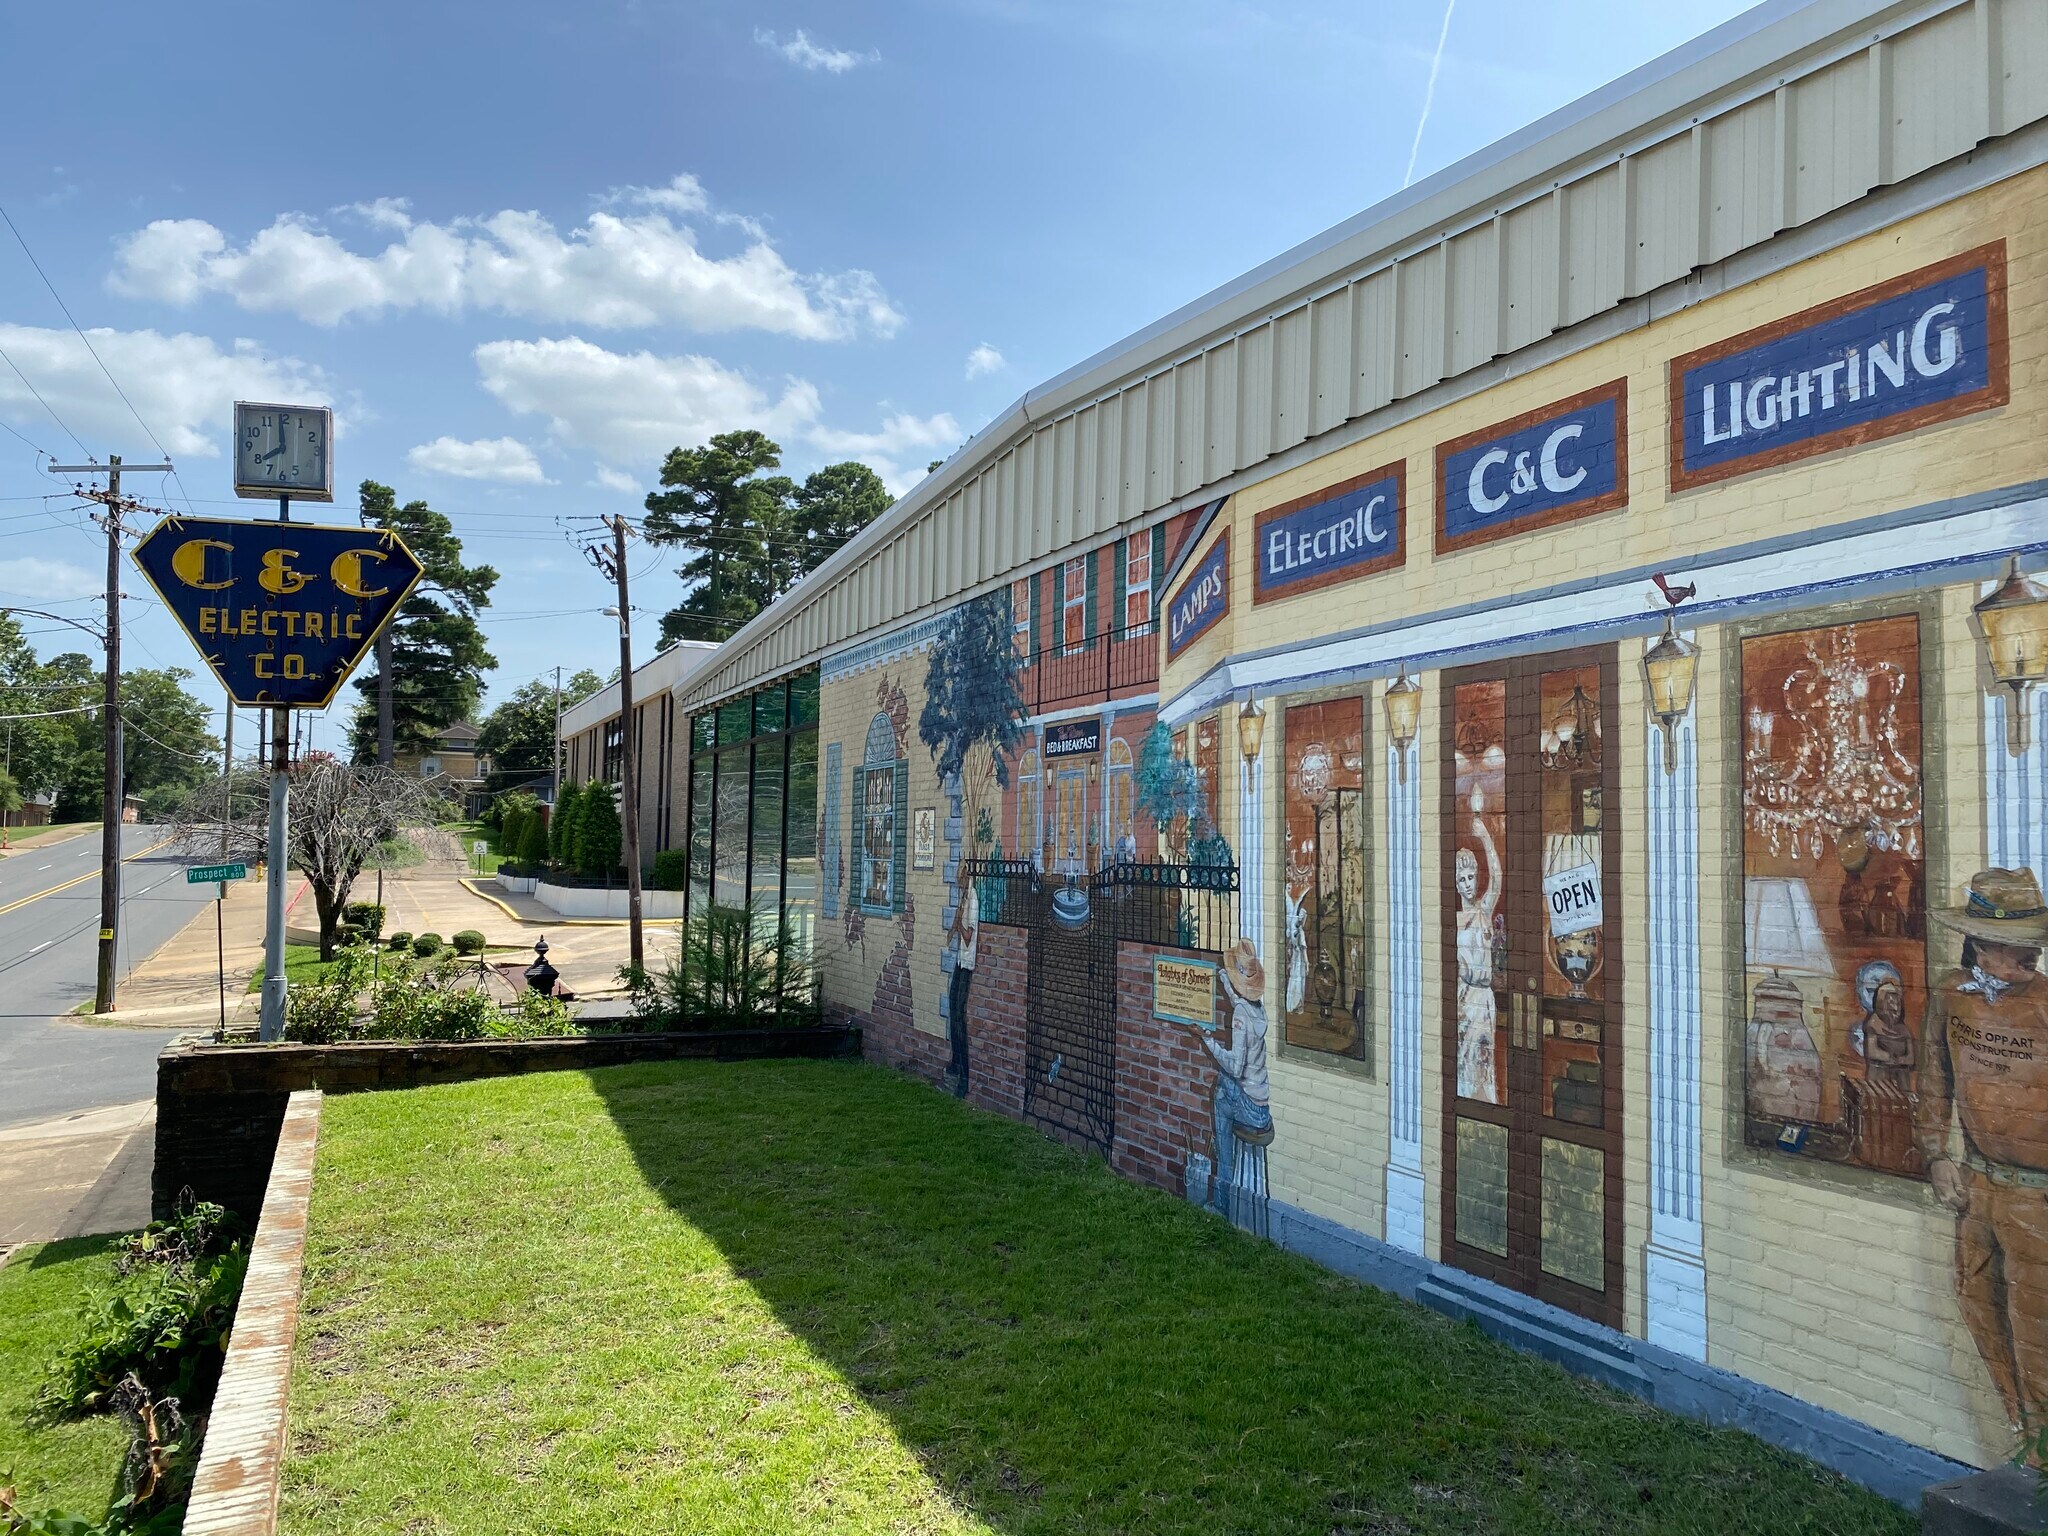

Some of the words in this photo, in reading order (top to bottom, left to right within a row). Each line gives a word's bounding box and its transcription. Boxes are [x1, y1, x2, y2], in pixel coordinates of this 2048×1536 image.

[1704, 302, 1958, 446] LIGHTING
[261, 416, 272, 427] 11
[298, 418, 303, 428] 1
[247, 427, 260, 438] 10
[308, 431, 316, 442] 2
[245, 441, 253, 451] 9
[313, 445, 321, 456] 3
[254, 453, 262, 464] 8
[266, 464, 273, 475] 7
[292, 466, 299, 476] 5
[279, 471, 286, 481] 6
[1268, 495, 1388, 574] ELECTRIC
[1172, 565, 1222, 642] LAMPS
[199, 607, 362, 640] ELECTRIC
[255, 653, 317, 680] CO.
[188, 867, 228, 880] Prospect
[1552, 880, 1596, 914] OPEN
[1950, 1015, 1982, 1040] CHRIS
[1985, 1032, 2008, 1045] OPP
[2010, 1037, 2035, 1049] ART
[1958, 1035, 2033, 1061] CONSTRUCTION
[1969, 1053, 1993, 1069] SINCE
